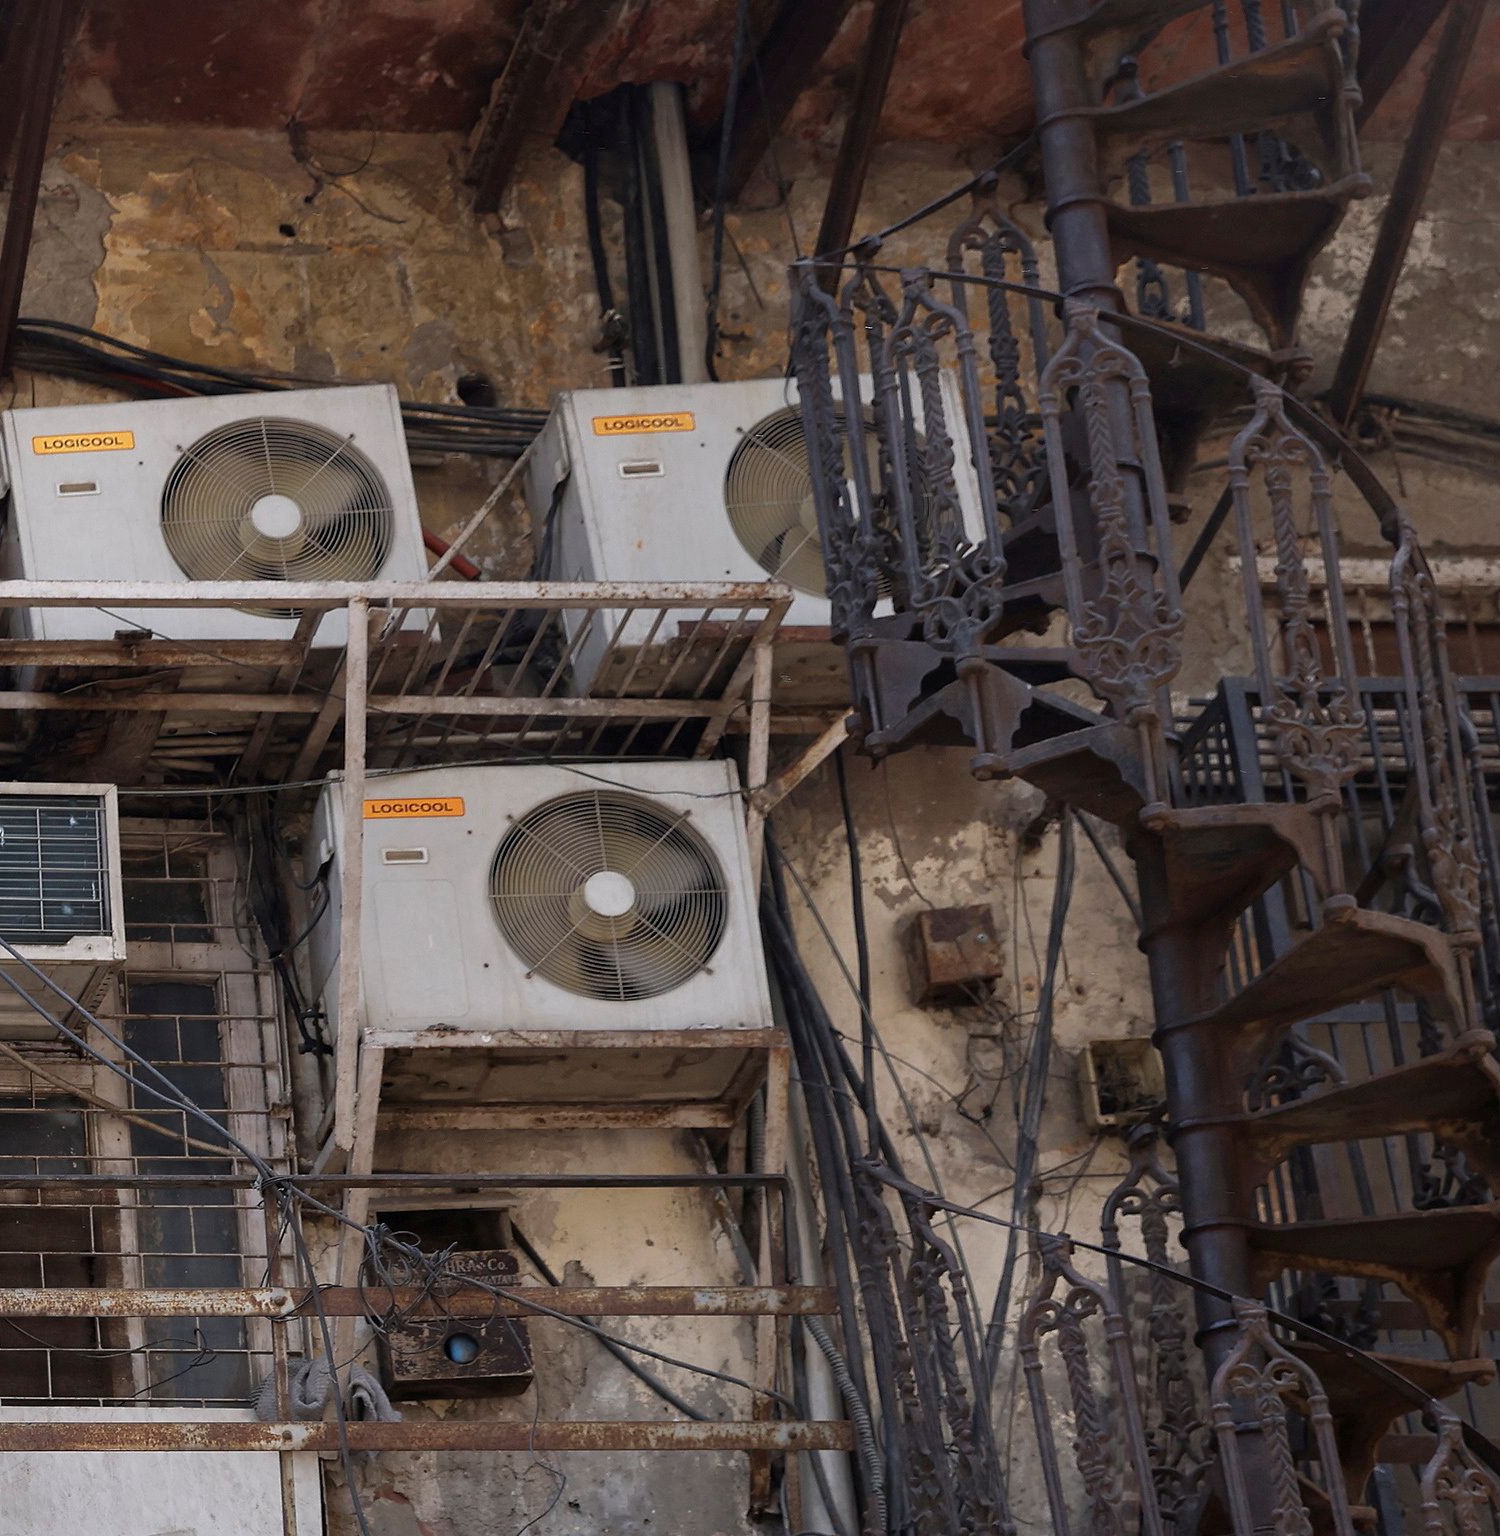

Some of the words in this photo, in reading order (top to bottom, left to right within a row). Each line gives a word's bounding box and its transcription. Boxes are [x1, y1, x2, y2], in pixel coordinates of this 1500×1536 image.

[603, 416, 686, 431] LOGICOOL
[44, 437, 124, 451] LOGICOOL
[371, 800, 454, 815] LOGICOOL
[487, 1257, 509, 1271] Co.
